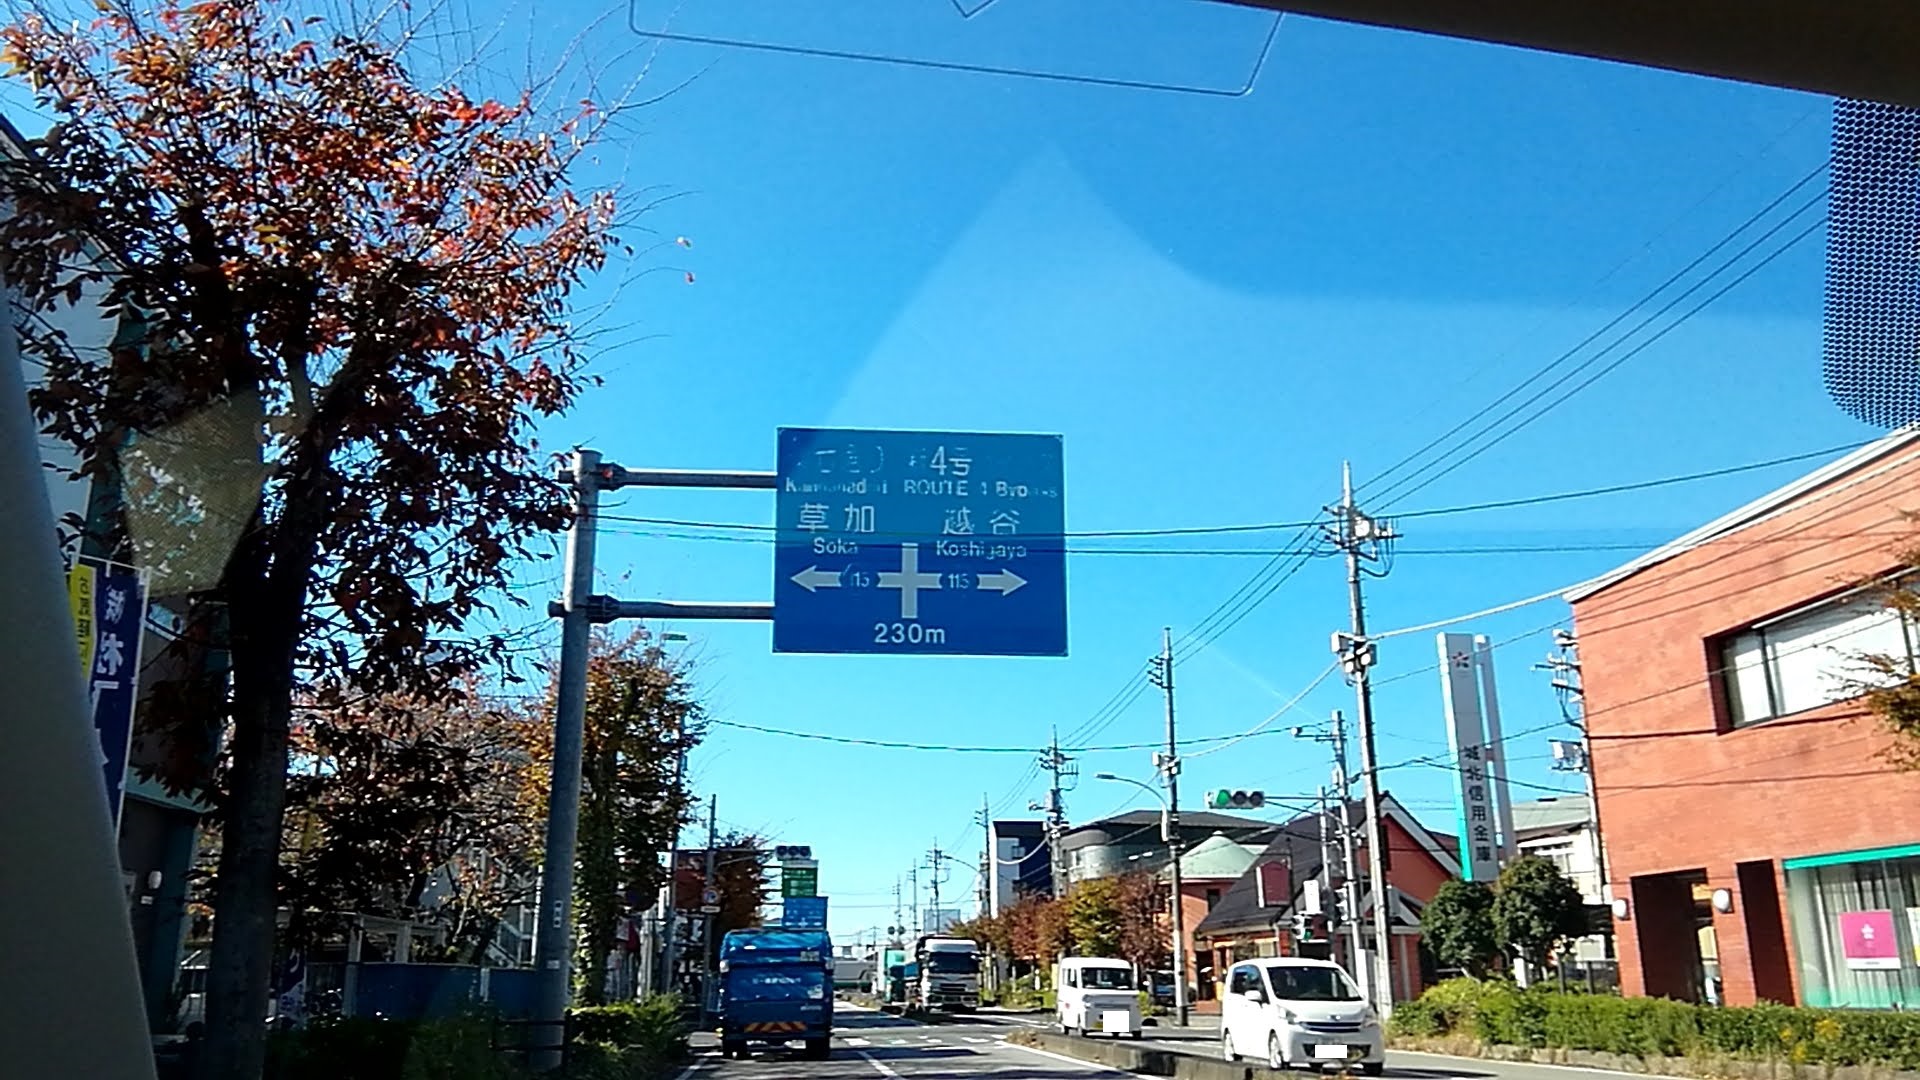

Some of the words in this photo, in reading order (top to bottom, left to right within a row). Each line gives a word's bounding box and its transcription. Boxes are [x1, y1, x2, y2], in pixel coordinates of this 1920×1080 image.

[904, 479, 968, 497] ROUTE
[797, 503, 875, 533] 草加
[943, 509, 1020, 535] 越谷
[813, 537, 858, 555] Soka
[936, 539, 1027, 561] Koshigaya
[947, 573, 970, 589] 115
[874, 622, 946, 645] 230m
